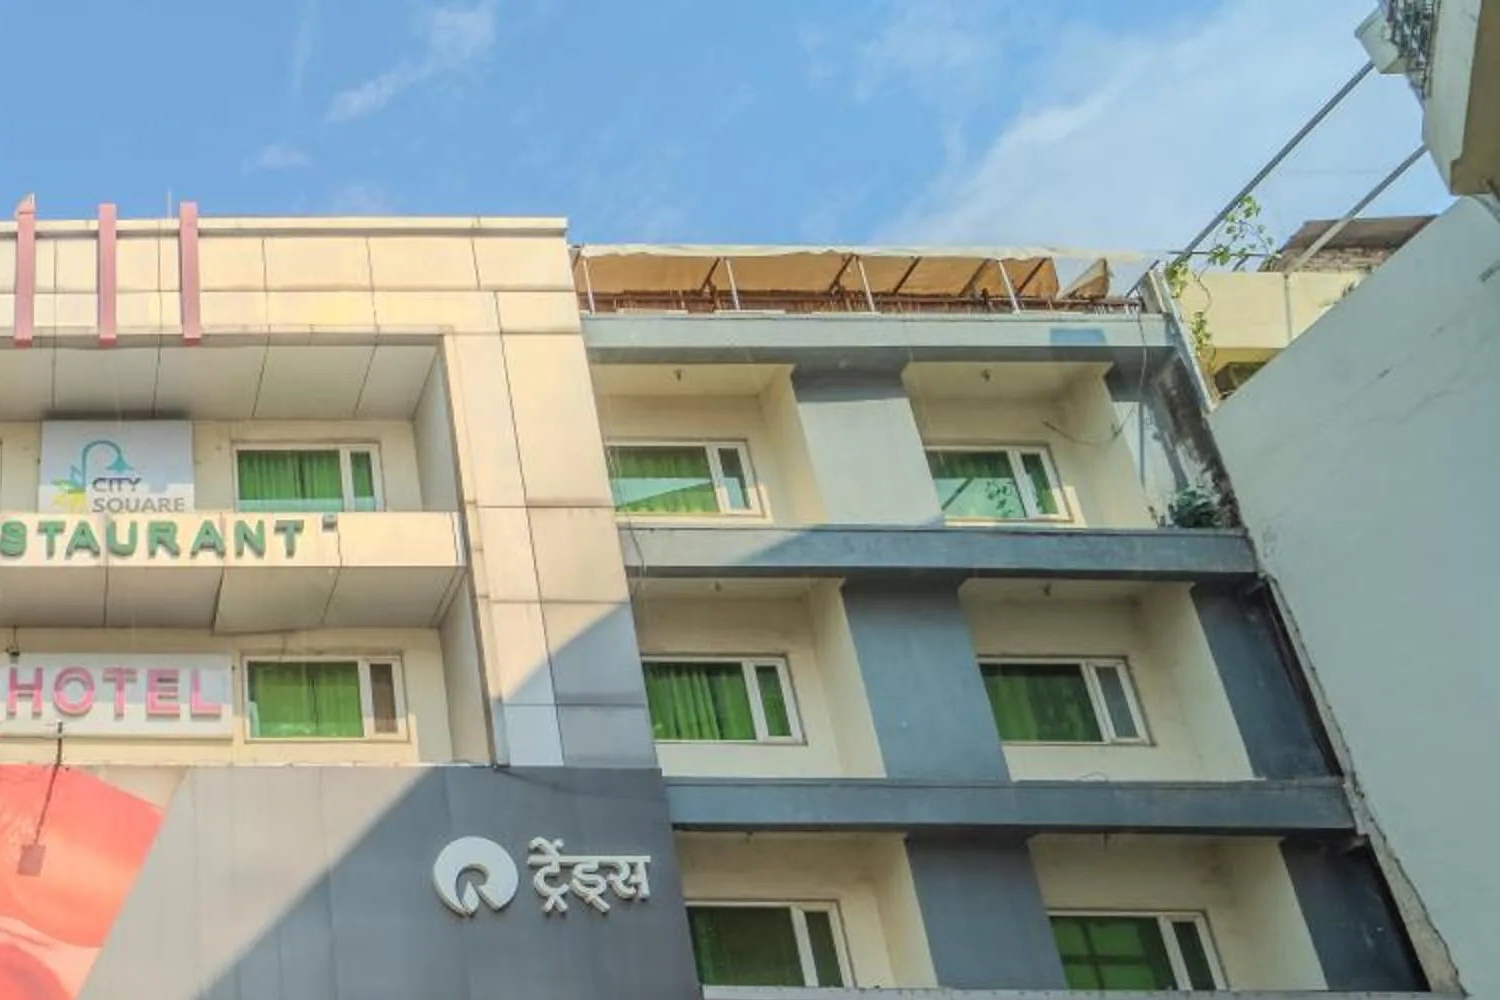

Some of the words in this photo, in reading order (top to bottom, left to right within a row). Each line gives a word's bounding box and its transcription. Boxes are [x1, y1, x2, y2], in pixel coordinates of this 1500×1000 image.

[92, 477, 143, 493] CITY
[92, 497, 185, 513] SQUARE
[5, 665, 223, 722] HOTEL
